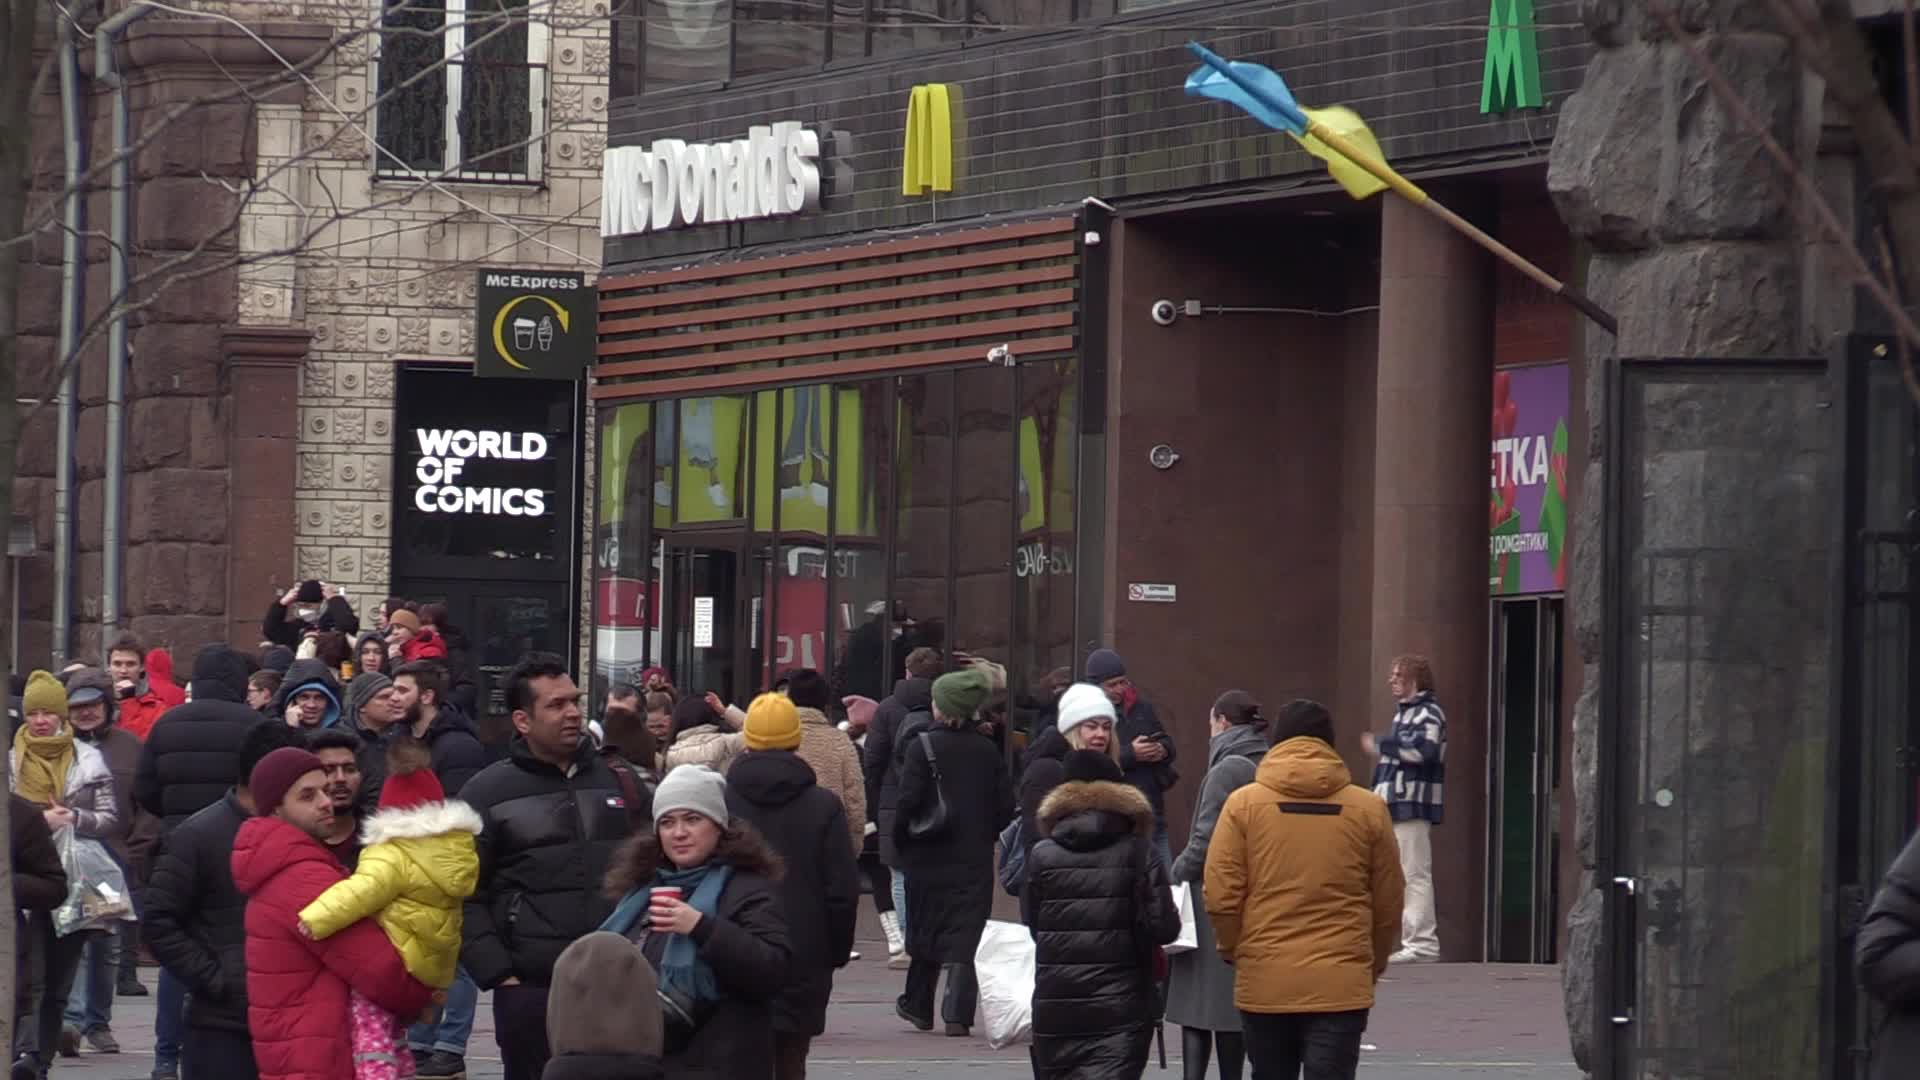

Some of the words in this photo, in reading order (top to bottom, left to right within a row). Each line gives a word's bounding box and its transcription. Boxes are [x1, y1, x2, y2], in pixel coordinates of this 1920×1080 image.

[601, 121, 820, 237] McDonald's
[485, 274, 579, 290] McExpress
[416, 428, 547, 460] WORLD
[416, 456, 465, 485] OF
[415, 485, 545, 517] COMICS
